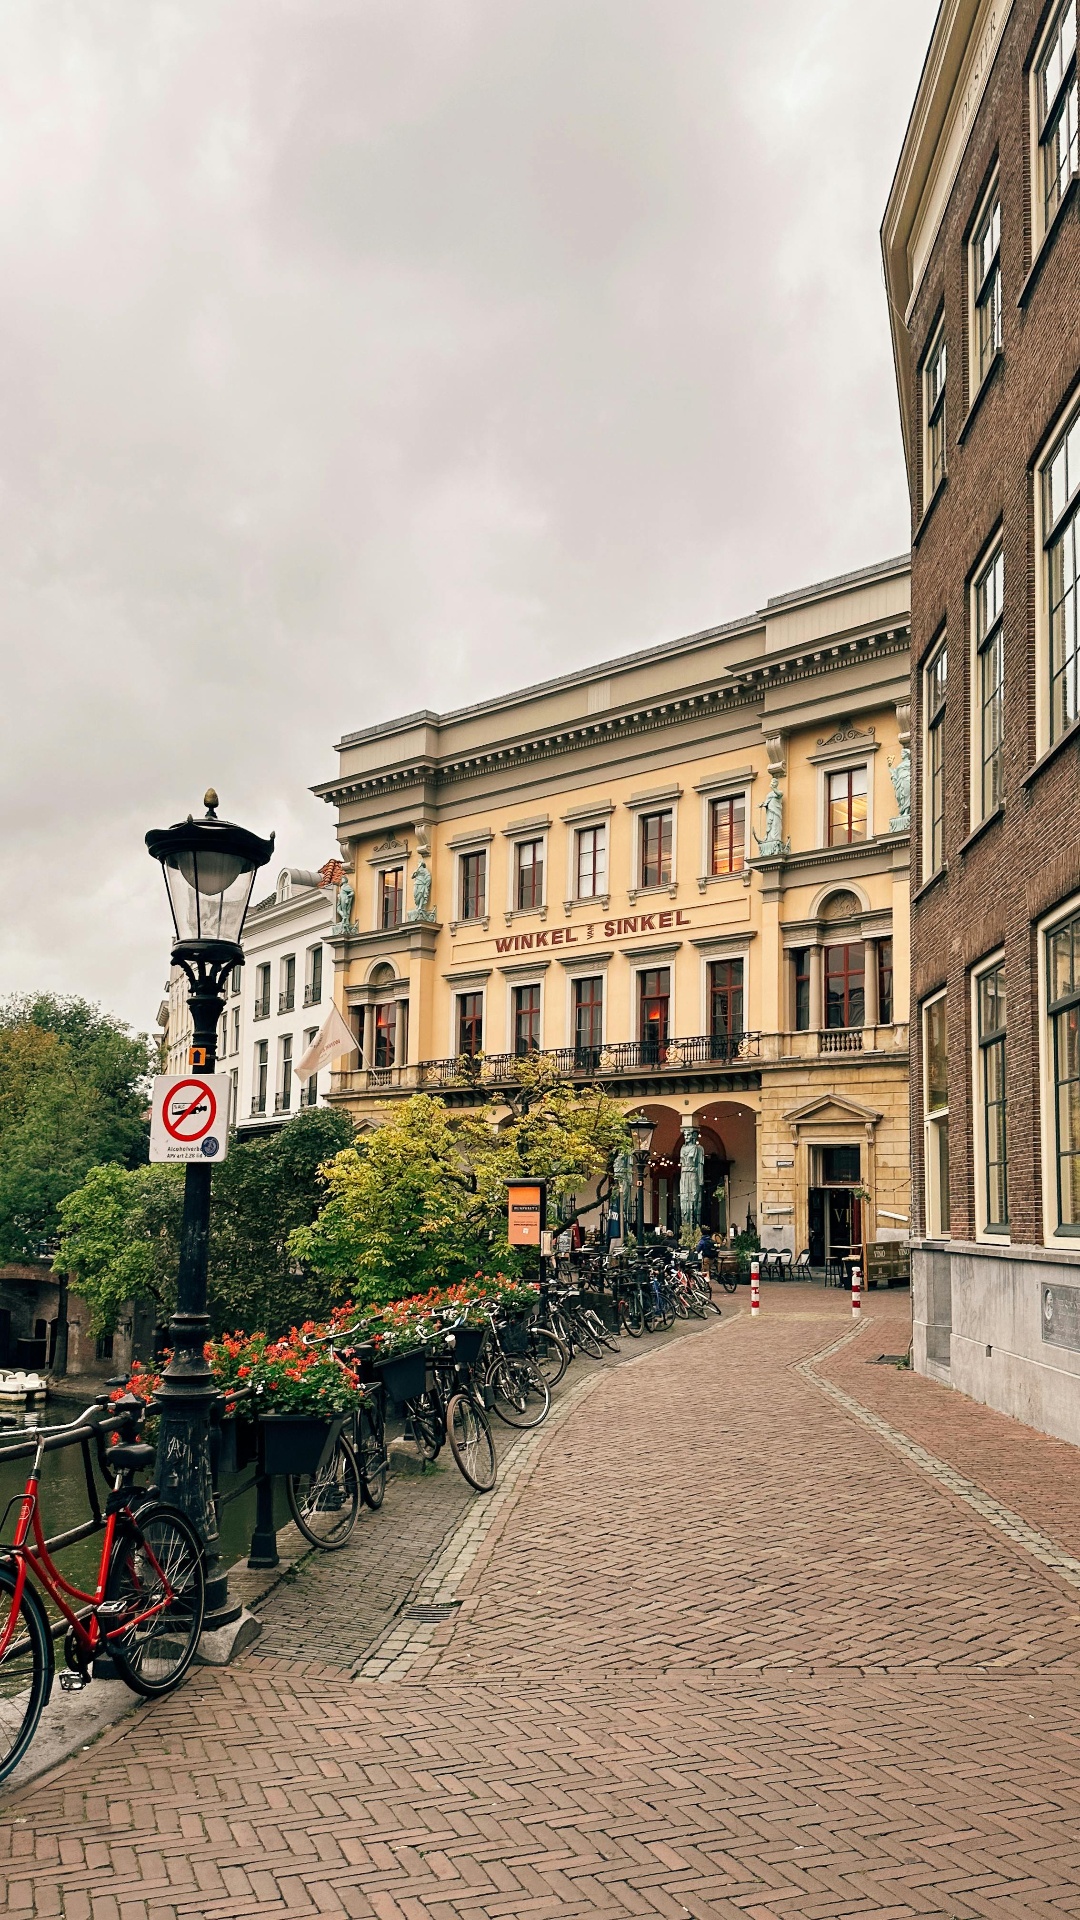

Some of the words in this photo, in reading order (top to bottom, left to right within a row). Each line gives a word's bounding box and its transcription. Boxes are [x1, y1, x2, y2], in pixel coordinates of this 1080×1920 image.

[495, 928, 579, 953] WINKEL
[587, 923, 595, 940] VAN
[604, 910, 691, 937] SINKEL
